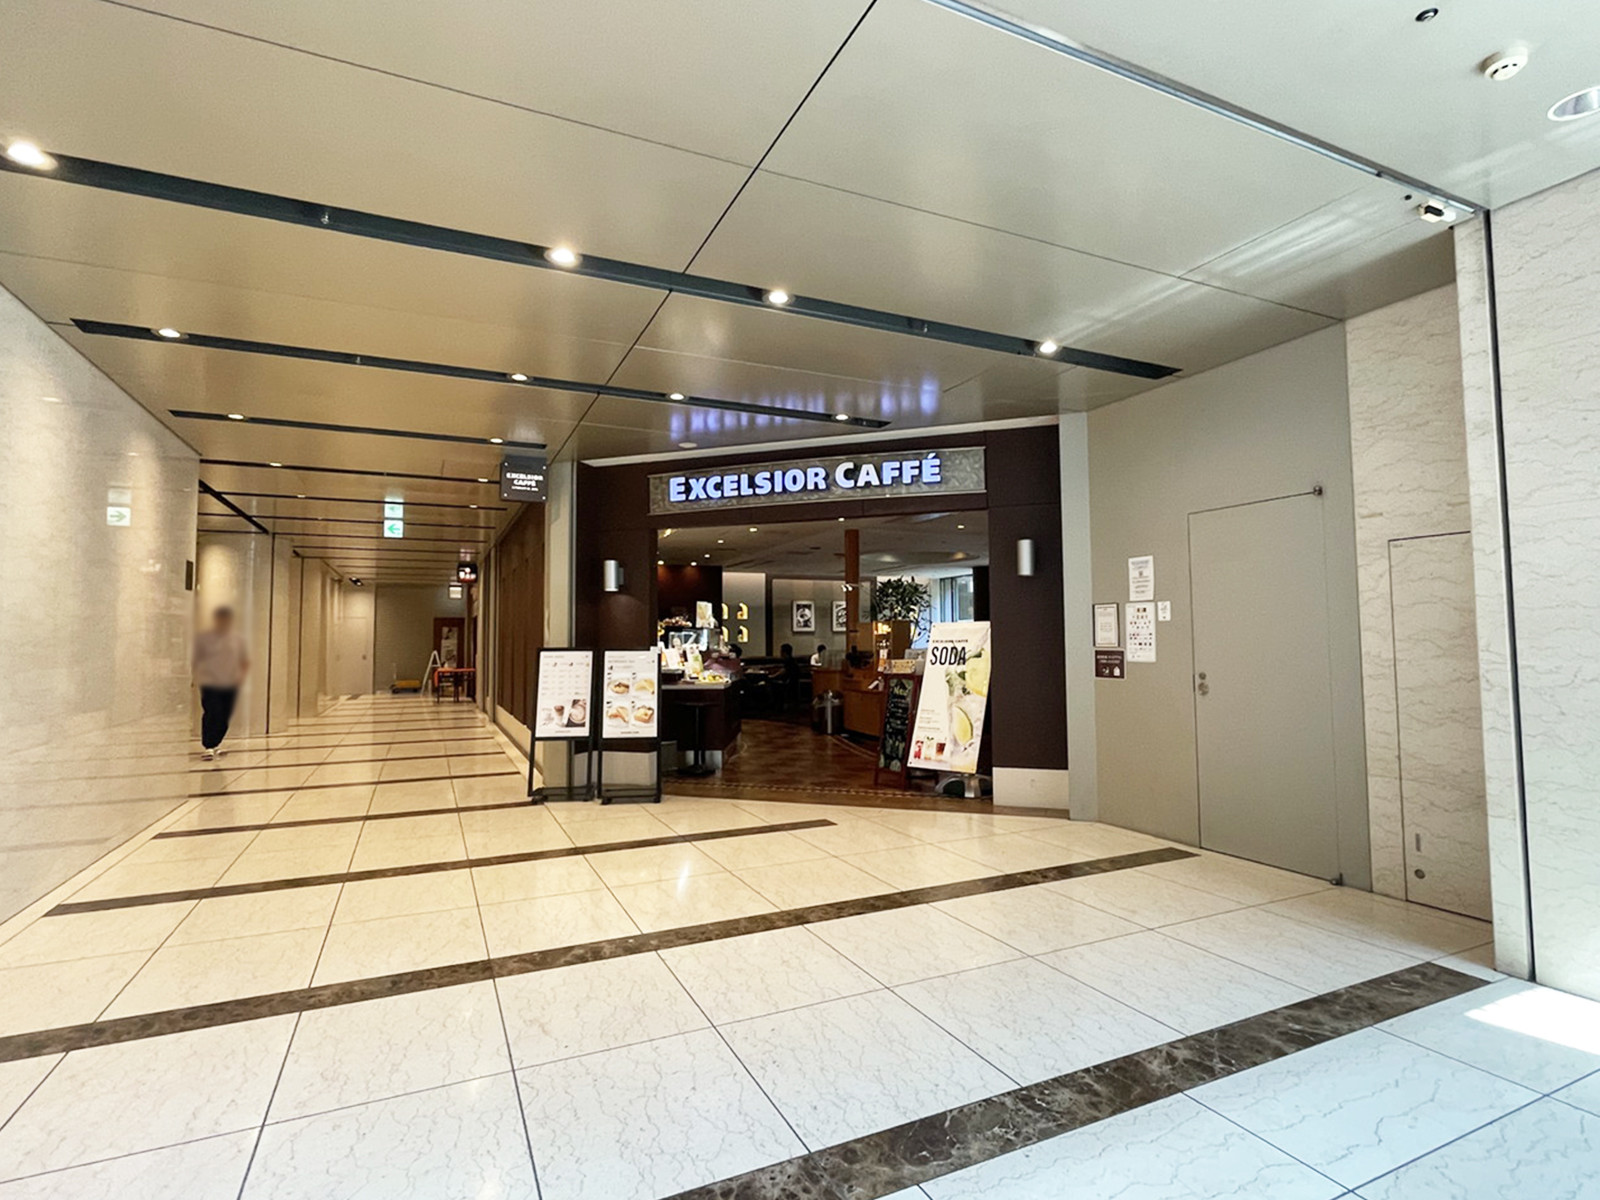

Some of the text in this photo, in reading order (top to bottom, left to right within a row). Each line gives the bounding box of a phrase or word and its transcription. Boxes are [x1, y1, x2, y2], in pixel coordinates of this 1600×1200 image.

[669, 452, 942, 502] EXCELSIOR CAFFÉ
[930, 646, 966, 666] SODA
